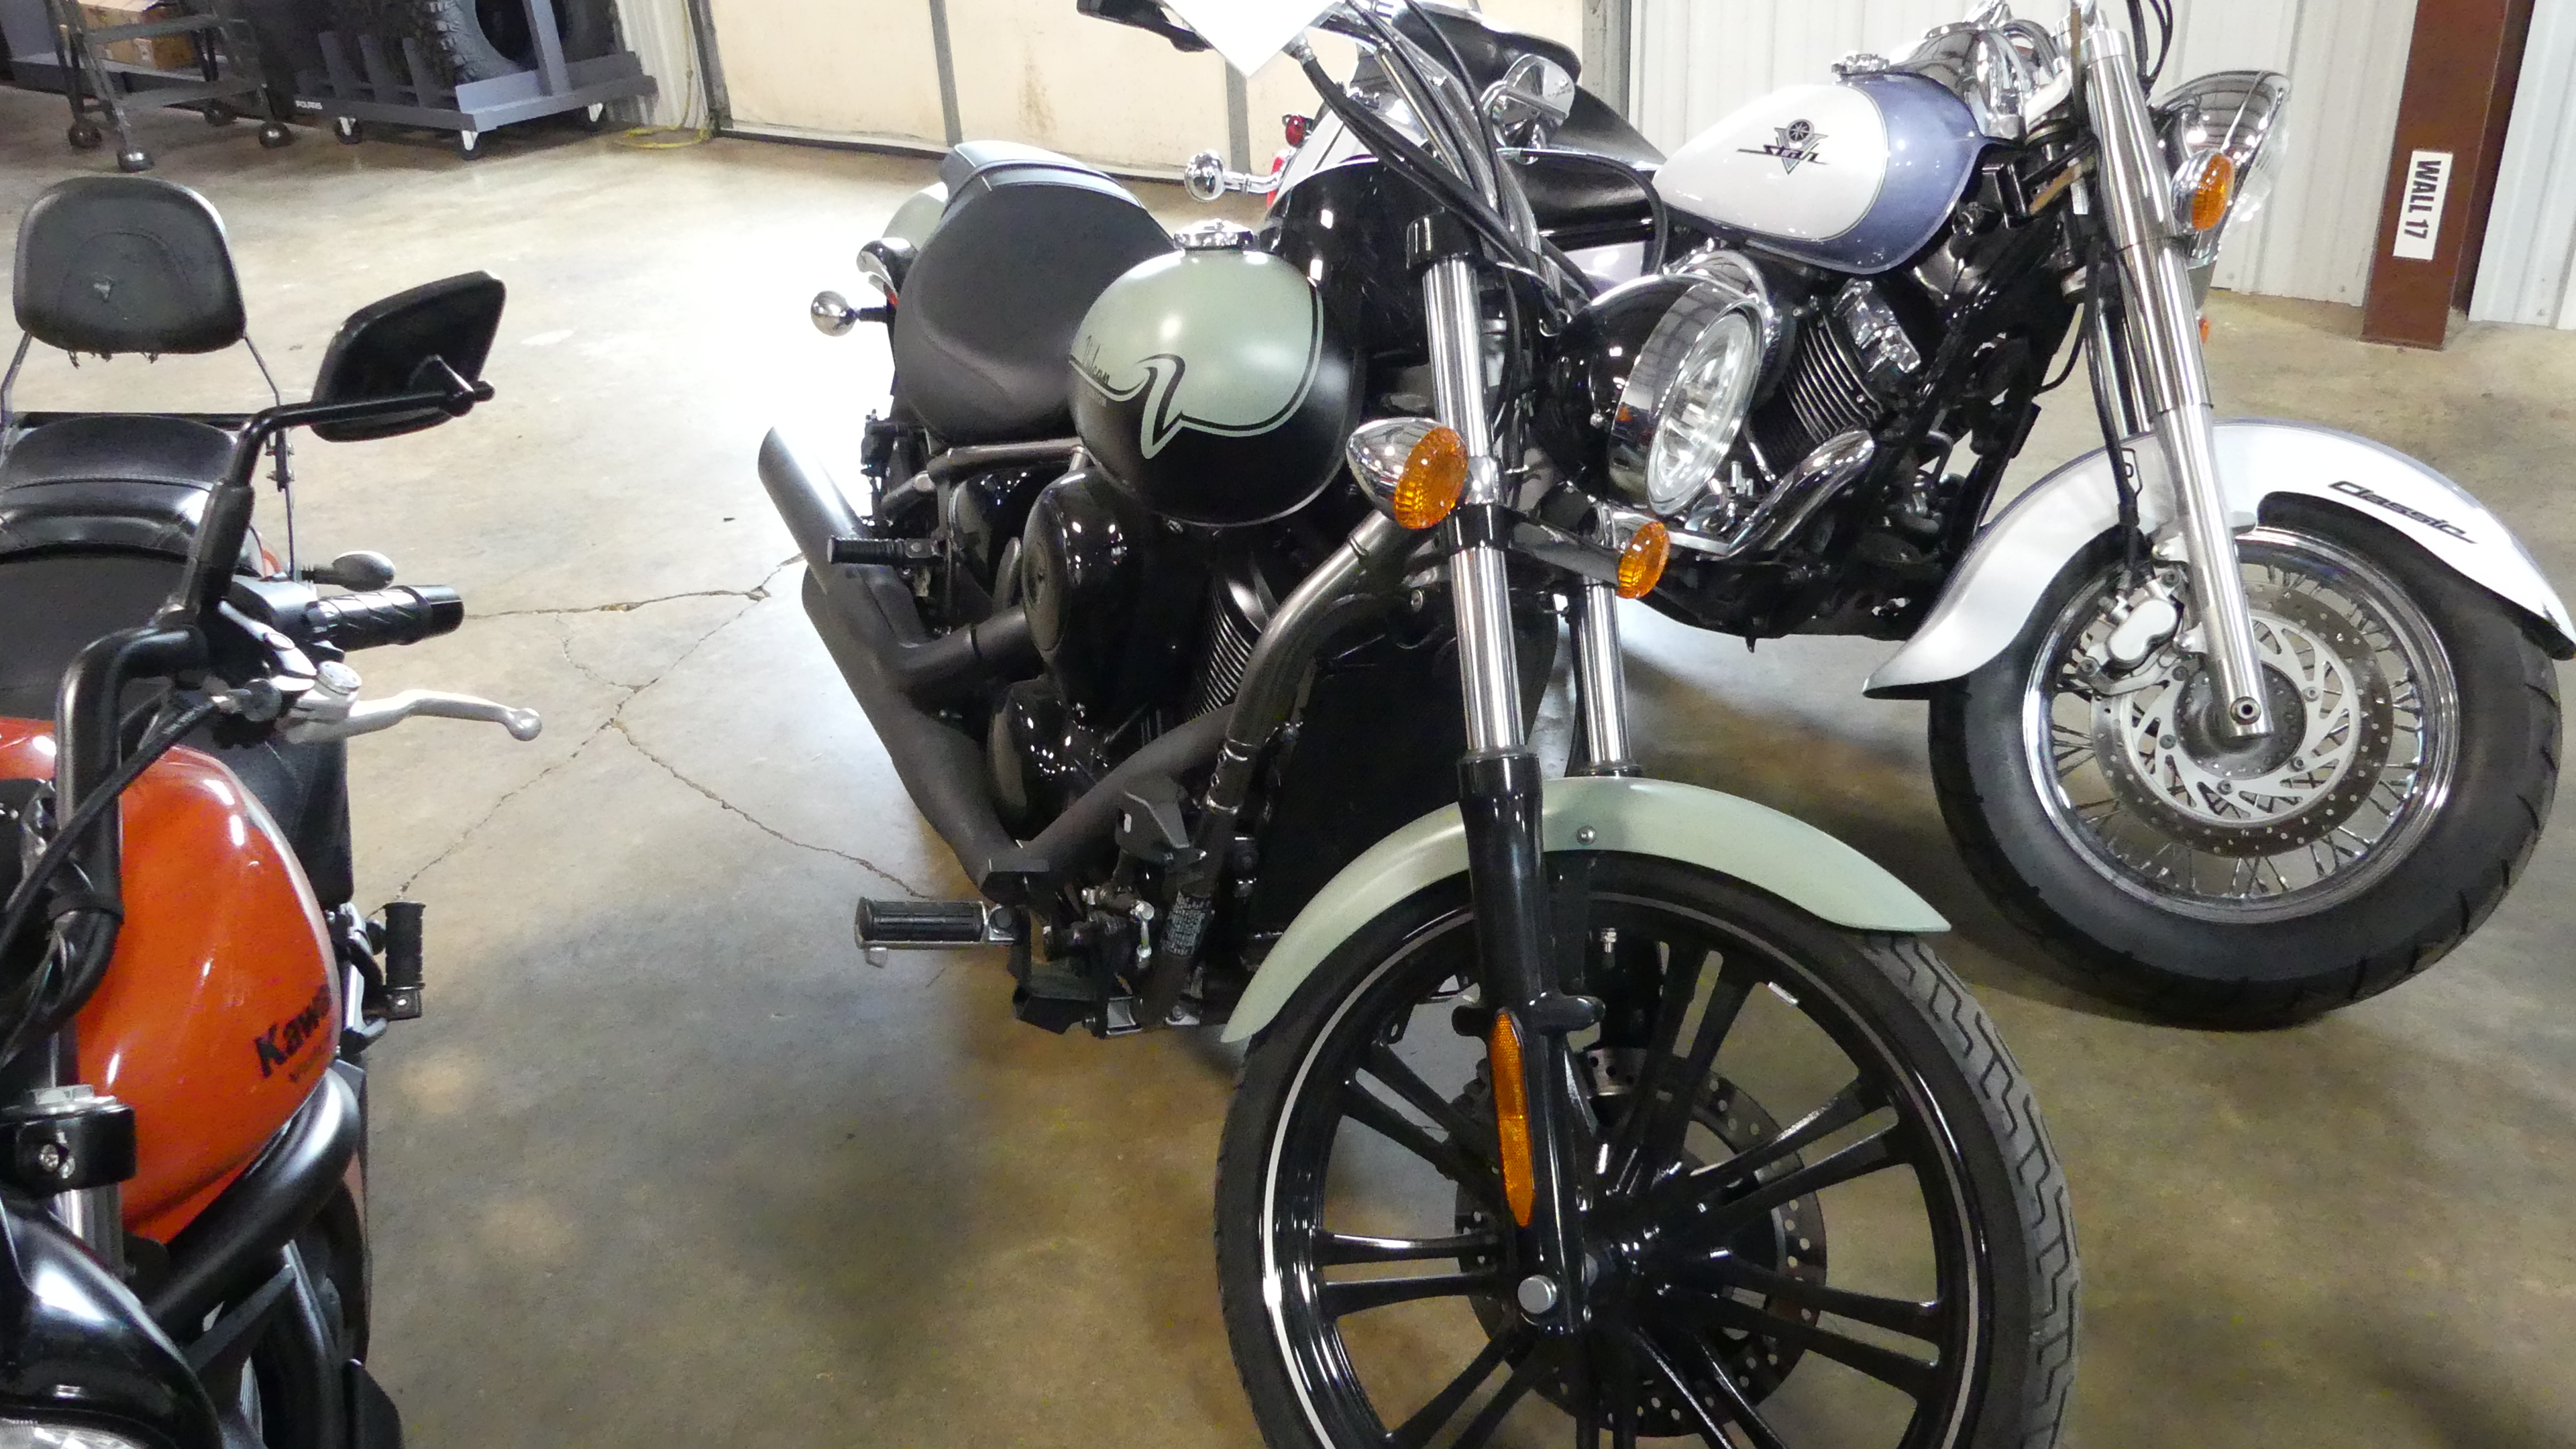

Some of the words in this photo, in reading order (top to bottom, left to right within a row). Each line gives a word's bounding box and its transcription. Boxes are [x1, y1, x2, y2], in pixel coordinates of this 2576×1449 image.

[2408, 160, 2442, 213] WALL
[2404, 219, 2429, 239] 17
[2327, 480, 2478, 545] Classic
